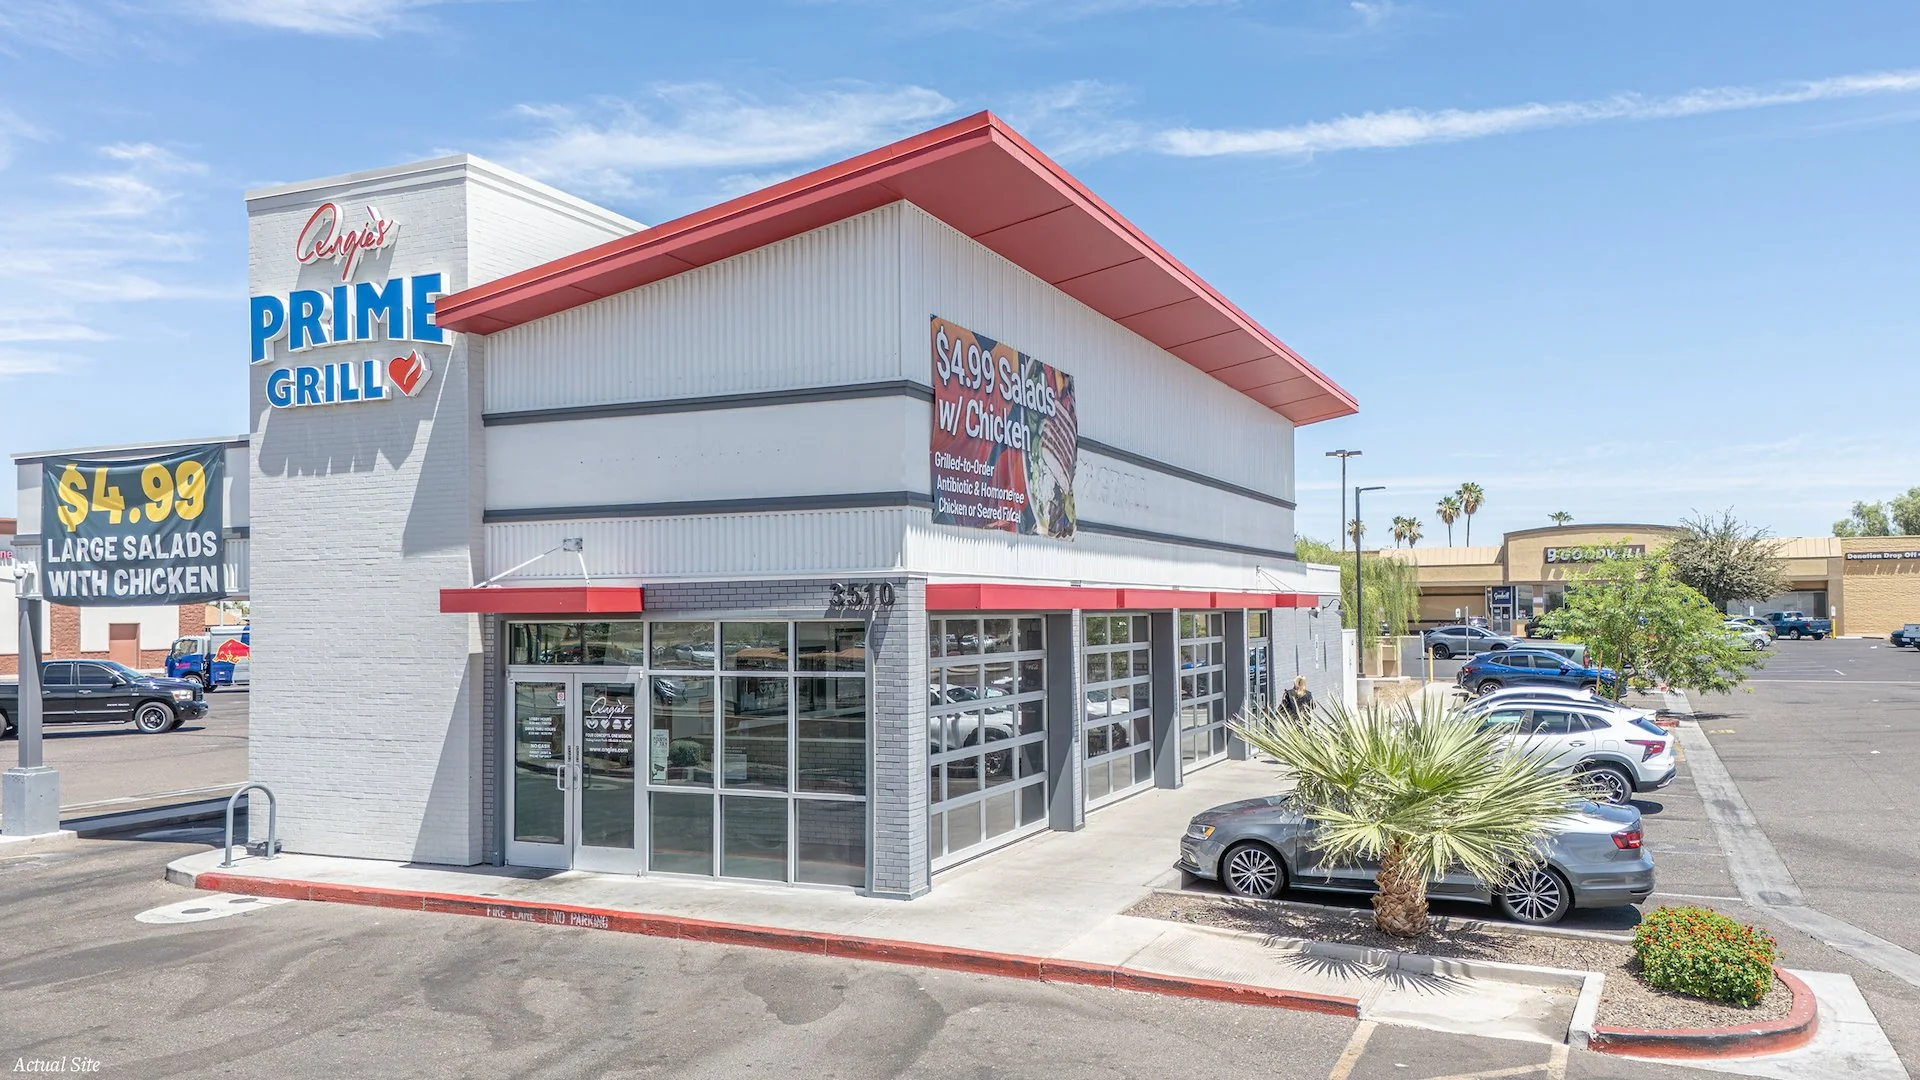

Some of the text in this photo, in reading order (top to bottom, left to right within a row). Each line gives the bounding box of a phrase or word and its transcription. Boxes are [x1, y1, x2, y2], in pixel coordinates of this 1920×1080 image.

[296, 202, 395, 281] Angie's
[250, 272, 445, 365] PRIME
[266, 359, 384, 408] GRILL
[935, 325, 1056, 417] $4.99 Salads
[938, 396, 1031, 451] w/ Chicken
[934, 451, 995, 477] Grilled-to-Order
[57, 460, 206, 532] $4.99
[936, 474, 973, 496] Antibiotic
[973, 480, 980, 497] &
[938, 497, 968, 517] Chicken
[968, 504, 976, 517] or
[47, 530, 218, 564] LARGE SALADS
[1847, 552, 1882, 560] Donation
[1883, 552, 1903, 560] Drop
[47, 565, 219, 597] WITH CHICKEN
[829, 582, 895, 607] 3510
[590, 696, 629, 720] Angie's
[486, 906, 507, 918] FIRE
[552, 911, 565, 924] NO
[570, 912, 609, 929] PARKING
